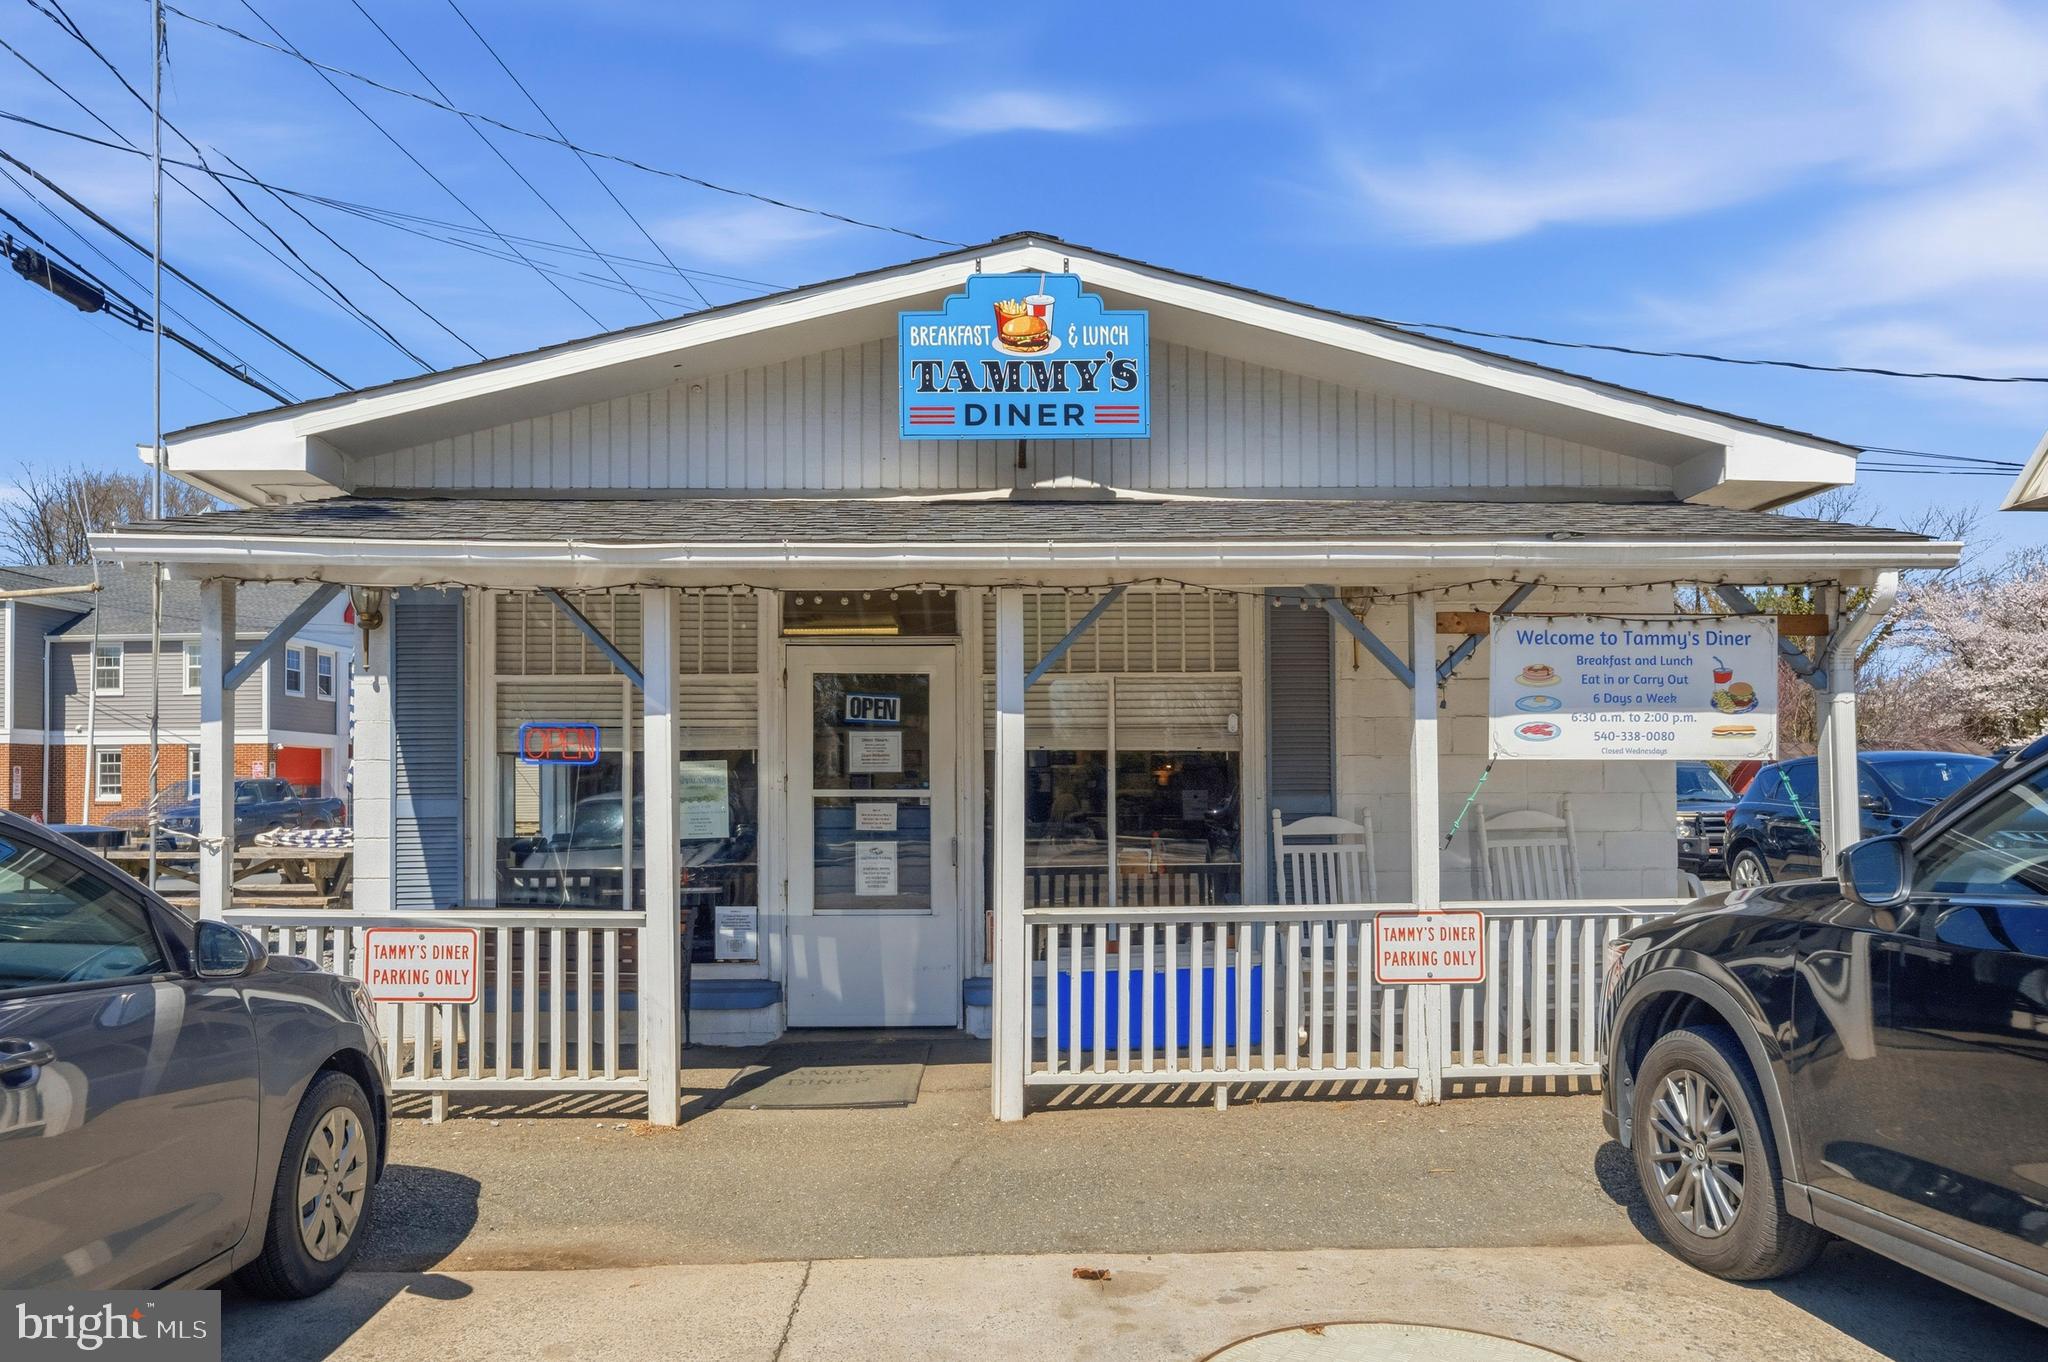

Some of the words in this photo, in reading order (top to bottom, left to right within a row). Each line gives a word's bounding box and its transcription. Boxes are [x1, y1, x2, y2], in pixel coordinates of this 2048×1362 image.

[910, 325, 991, 347] BREAKFAST
[1068, 322, 1078, 348] &
[1083, 325, 1129, 346] LUNCH
[911, 350, 1139, 394] TAMMY'S
[965, 404, 1084, 426] DINER
[1516, 629, 1594, 646] Welcome
[1600, 631, 1618, 646] to
[1623, 630, 1700, 650] Tammy's
[1706, 630, 1752, 646] Diner
[1576, 655, 1631, 668] Breakfast
[1635, 655, 1657, 666] and
[1660, 655, 1693, 666] Lunch
[1581, 674, 1600, 685] Eat
[1604, 673, 1614, 685] in
[1618, 676, 1630, 685] or
[1633, 674, 1664, 687] Carry
[1667, 674, 1688, 685] Out
[1593, 693, 1600, 704] 6
[1603, 693, 1632, 706] Days
[1635, 695, 1643, 704] a
[1646, 693, 1677, 704] Week
[849, 696, 897, 720] OPEN
[1571, 712, 1596, 723] 6:30
[1600, 714, 1625, 723] a.m.
[1629, 712, 1641, 723] to
[1643, 712, 1669, 723] 2:00
[1672, 714, 1697, 725] p.m.
[525, 728, 596, 759] OPEN
[1594, 731, 1675, 742] 540-338-0080
[1601, 747, 1624, 755] Closed
[1625, 747, 1668, 756] Wednesdays
[1383, 926, 1435, 942] TAMMY'S
[1440, 926, 1476, 941] DINER
[373, 944, 427, 960] TAMMY'S
[432, 944, 470, 960] DINER
[1384, 951, 1438, 966] PARKING
[1443, 950, 1477, 966] ONLY
[373, 969, 429, 985] PARKING
[435, 969, 470, 985] ONLY
